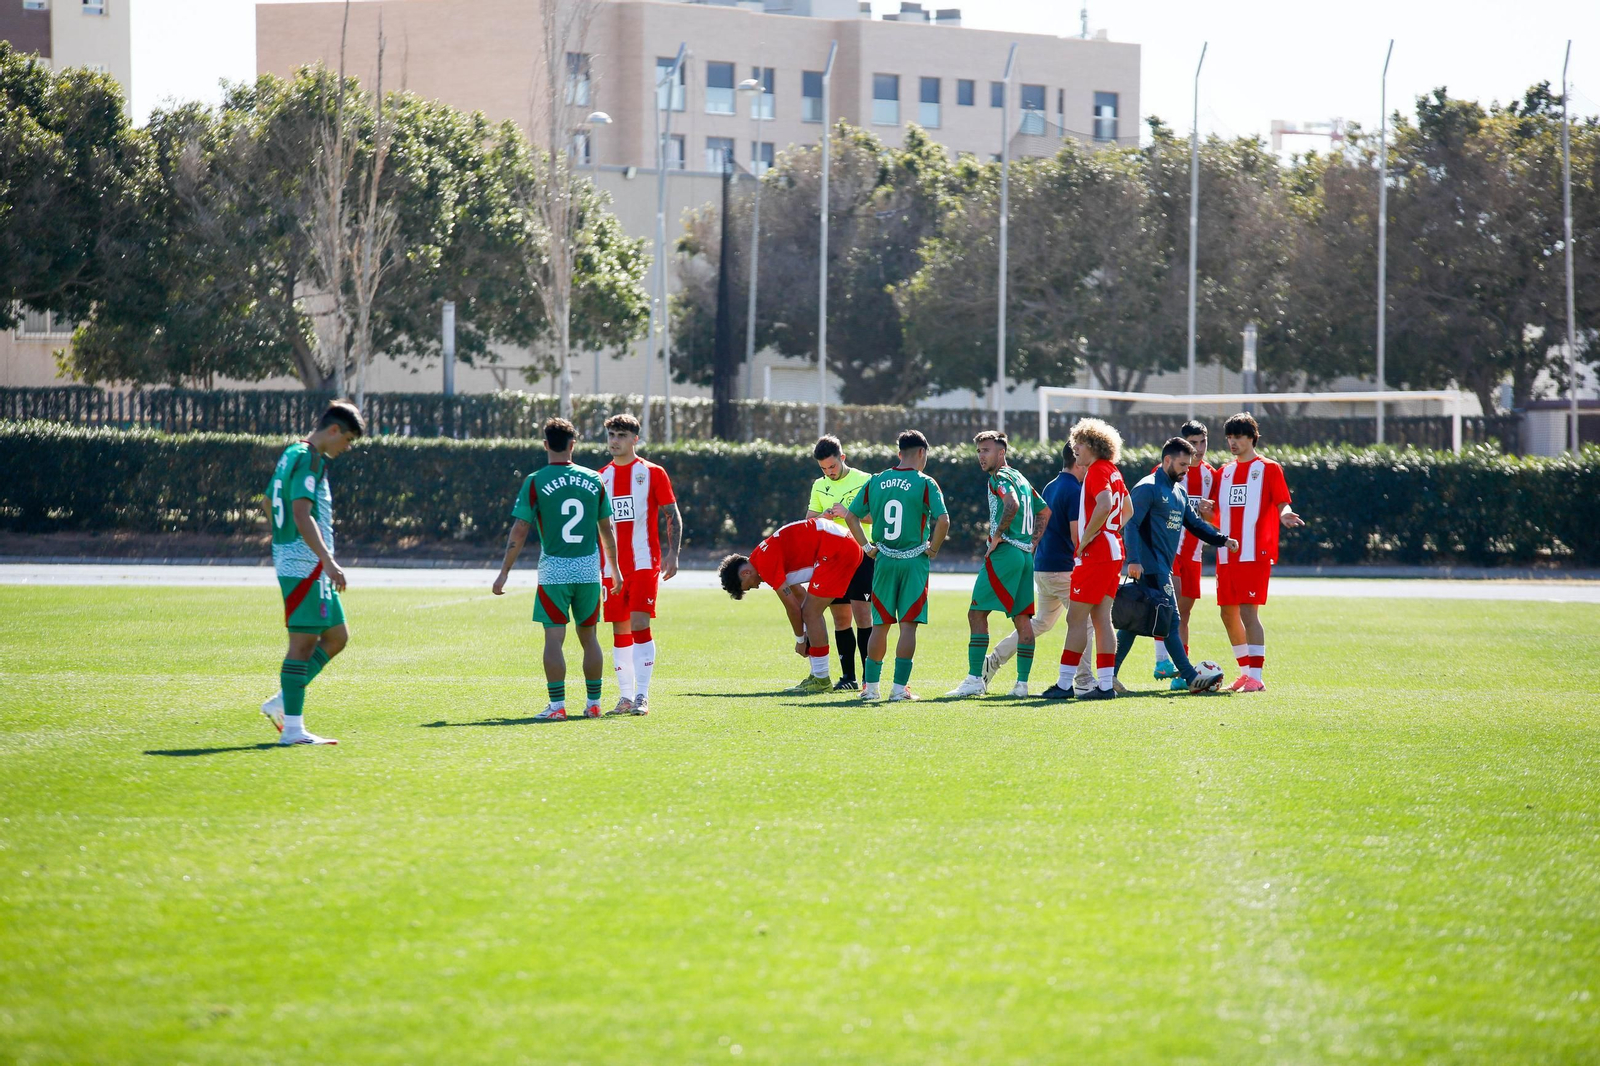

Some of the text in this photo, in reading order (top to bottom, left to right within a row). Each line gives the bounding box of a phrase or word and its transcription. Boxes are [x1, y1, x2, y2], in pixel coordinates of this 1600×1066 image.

[541, 476, 567, 496] IKER
[880, 478, 912, 491] CORTÉS
[617, 501, 629, 509] DA
[618, 509, 630, 517] ZN
[1020, 494, 1034, 536] 10
[561, 498, 584, 543] 2
[884, 499, 903, 541] 9
[317, 579, 333, 601] 15
